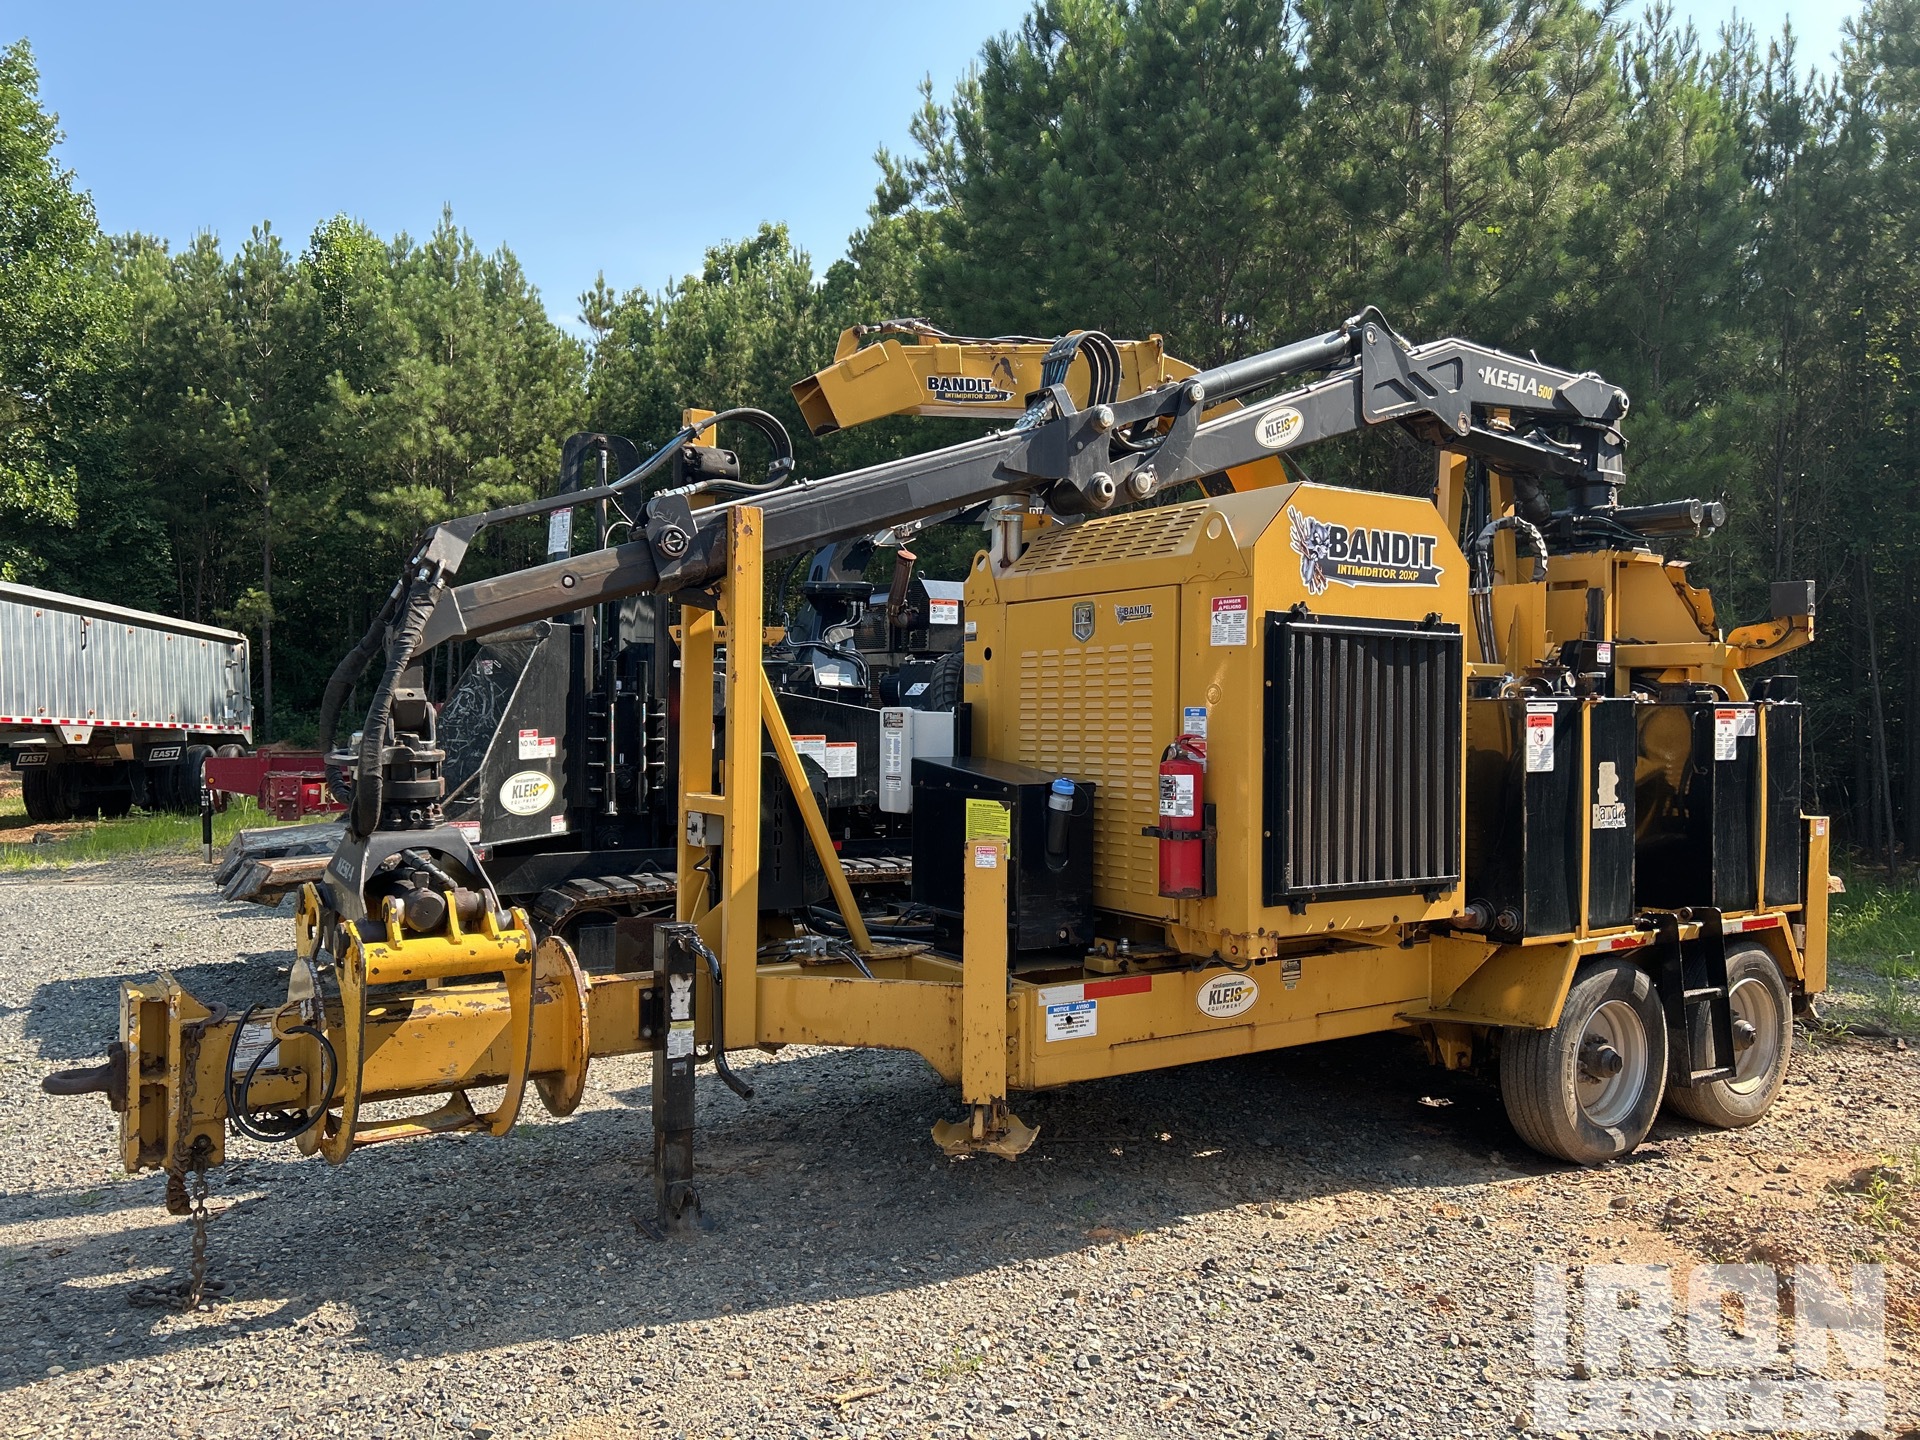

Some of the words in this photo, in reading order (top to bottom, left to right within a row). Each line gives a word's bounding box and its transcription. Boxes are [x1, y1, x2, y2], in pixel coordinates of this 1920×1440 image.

[927, 376, 992, 392] BANDIT
[1483, 366, 1538, 397] KESLA
[1537, 384, 1553, 400] 500
[944, 392, 984, 400] INTIMIDATOR
[1264, 417, 1291, 439] KLEIS
[1329, 526, 1436, 567] BANDIT
[1337, 563, 1397, 579] INTIMIDATOR
[1398, 570, 1419, 581] 20XP
[1123, 604, 1152, 616] BANDIT
[20, 755, 45, 763] EAST
[511, 782, 540, 800] KLEIS
[774, 776, 783, 882] BANDIT
[1208, 986, 1243, 1006] KLEIS
[1053, 1005, 1070, 1013] NOTICE
[1207, 1002, 1241, 1013] EQUIPMENT
